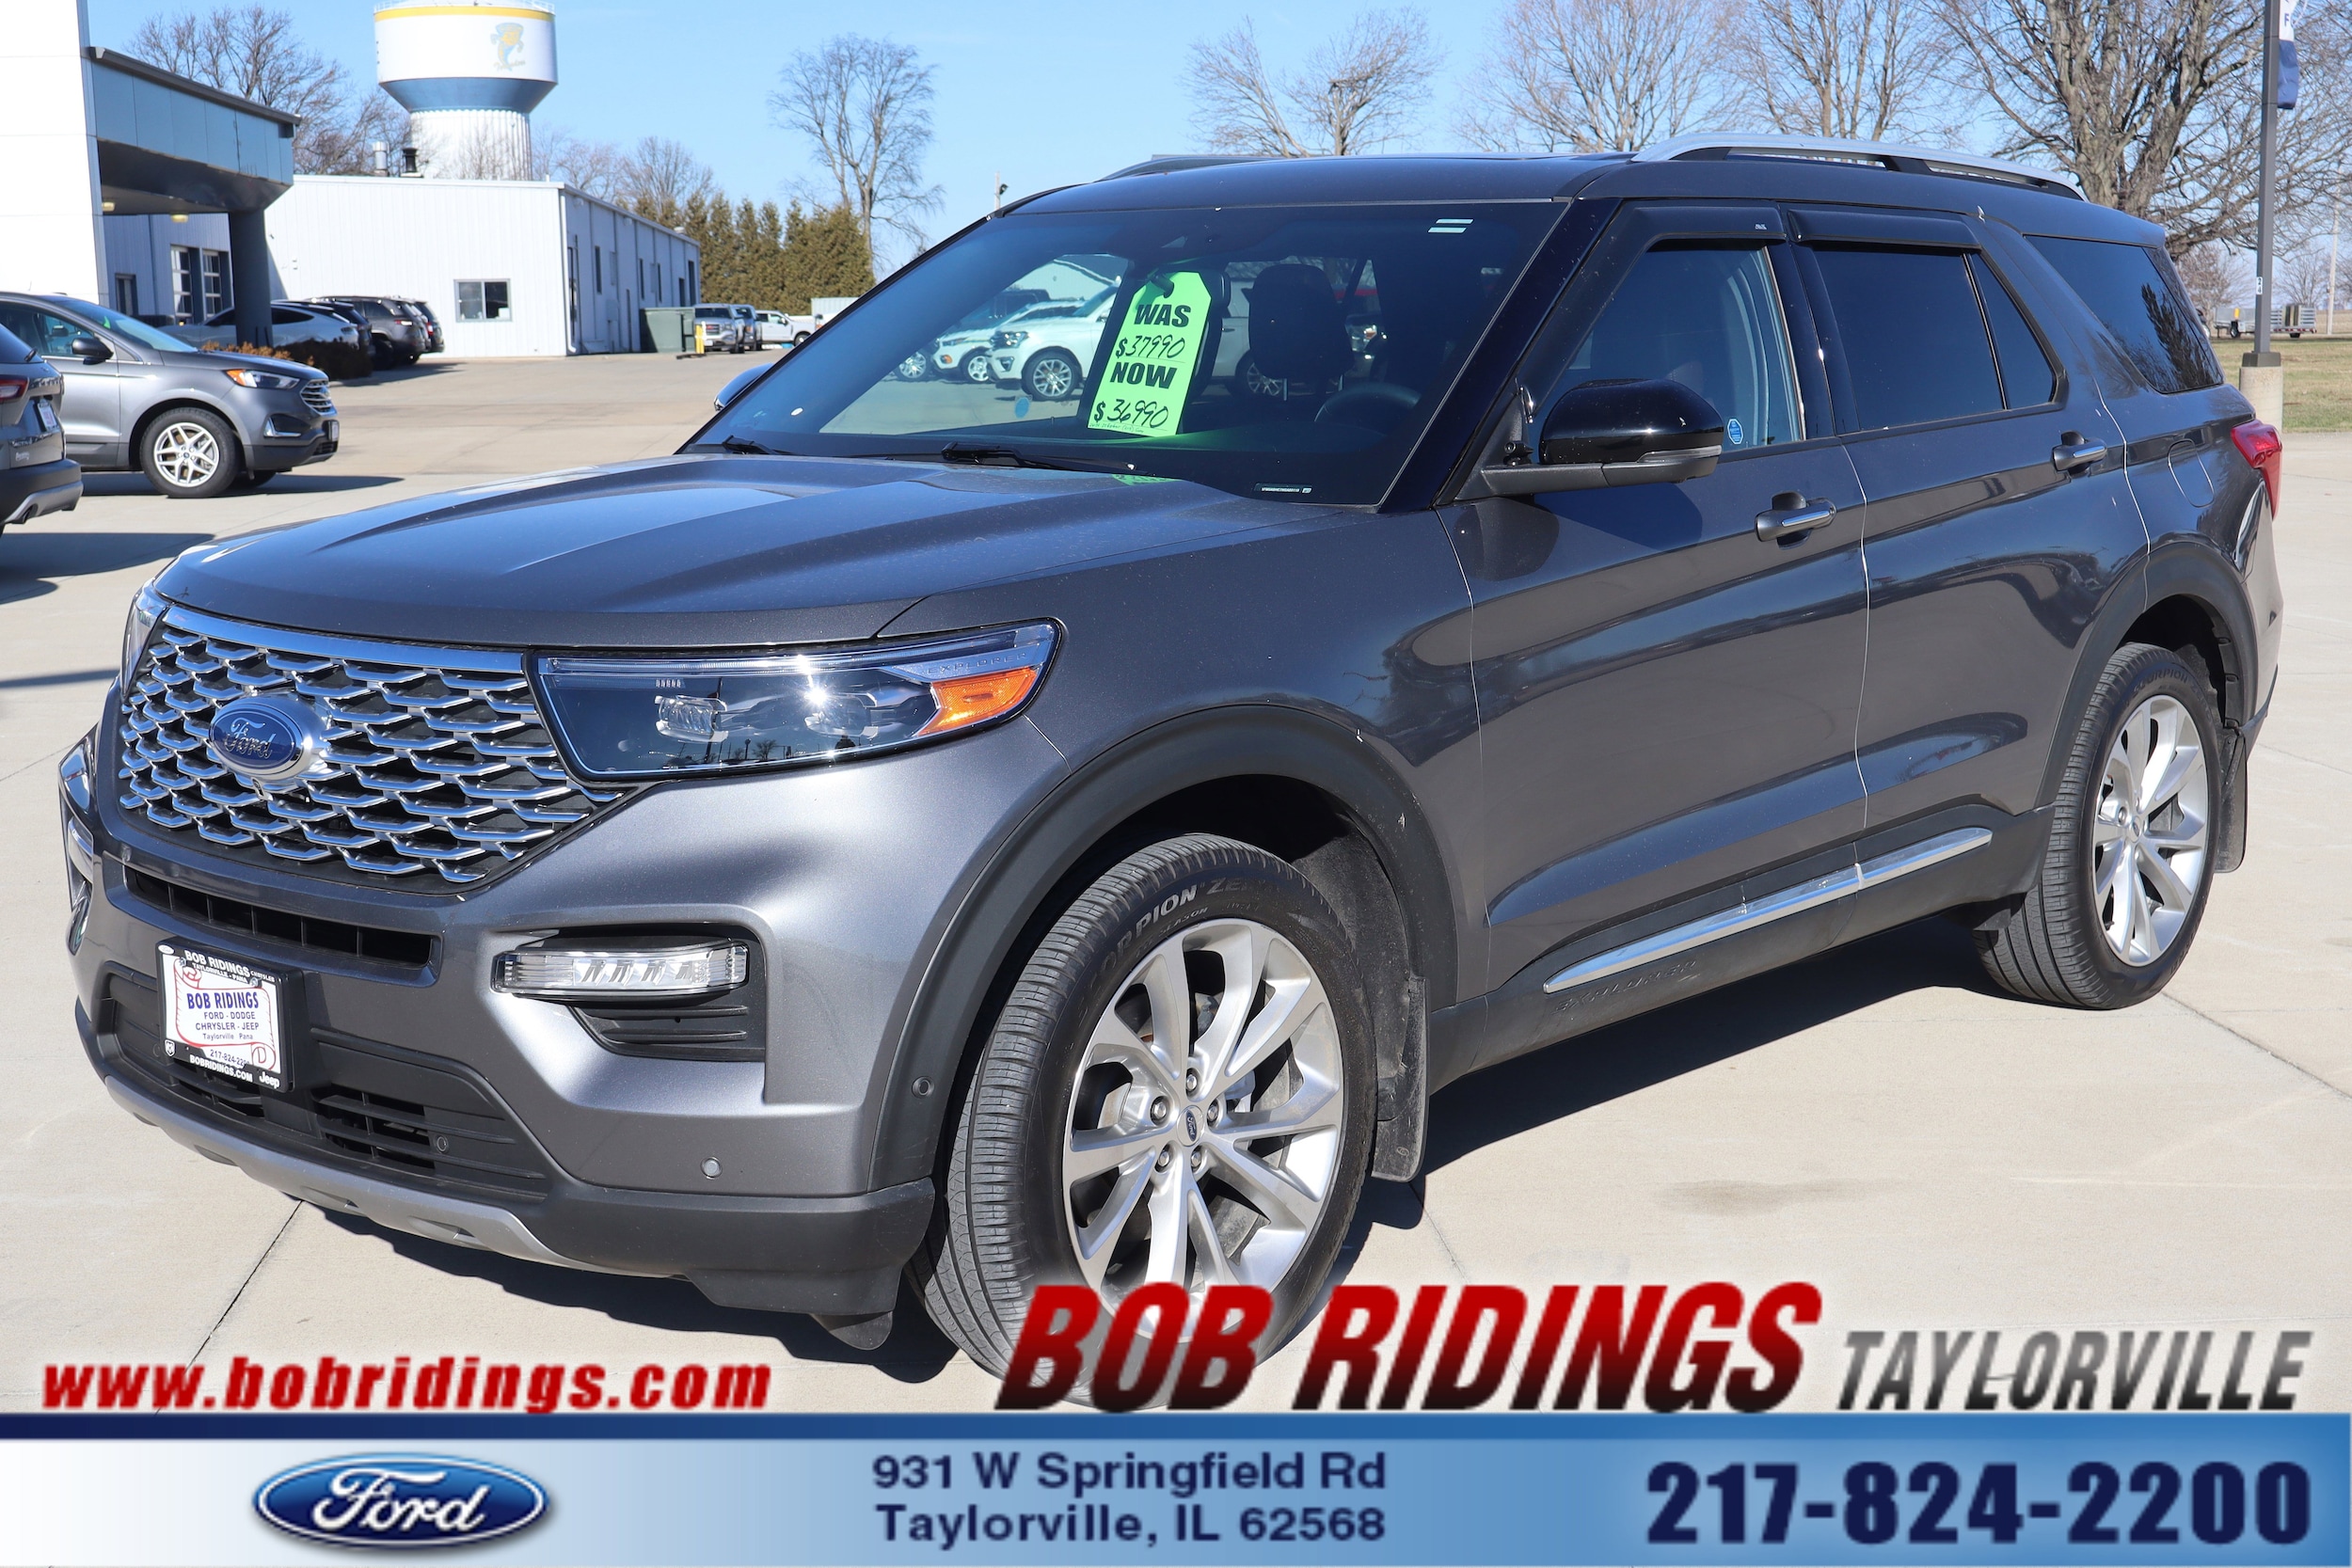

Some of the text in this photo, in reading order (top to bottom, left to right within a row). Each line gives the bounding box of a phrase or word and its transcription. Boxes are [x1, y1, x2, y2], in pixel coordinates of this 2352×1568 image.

[1134, 304, 1191, 327] WAS
[1115, 334, 1185, 359] $37990
[1109, 361, 1177, 389] NOW
[1093, 398, 1169, 429] $36990
[927, 653, 1025, 674] EXPLORER
[225, 717, 277, 759] Ford
[184, 949, 207, 965] BOB
[208, 957, 250, 977] RIDINGS
[186, 991, 259, 1009] BOB RIDINGS
[195, 1022, 236, 1031] CHRYSLER
[203, 1011, 256, 1020] FORD DODGE
[202, 1033, 234, 1041] Taylorville
[189, 1054, 253, 1083] BOBRIDINGS.COM
[259, 1070, 280, 1089] Jeep
